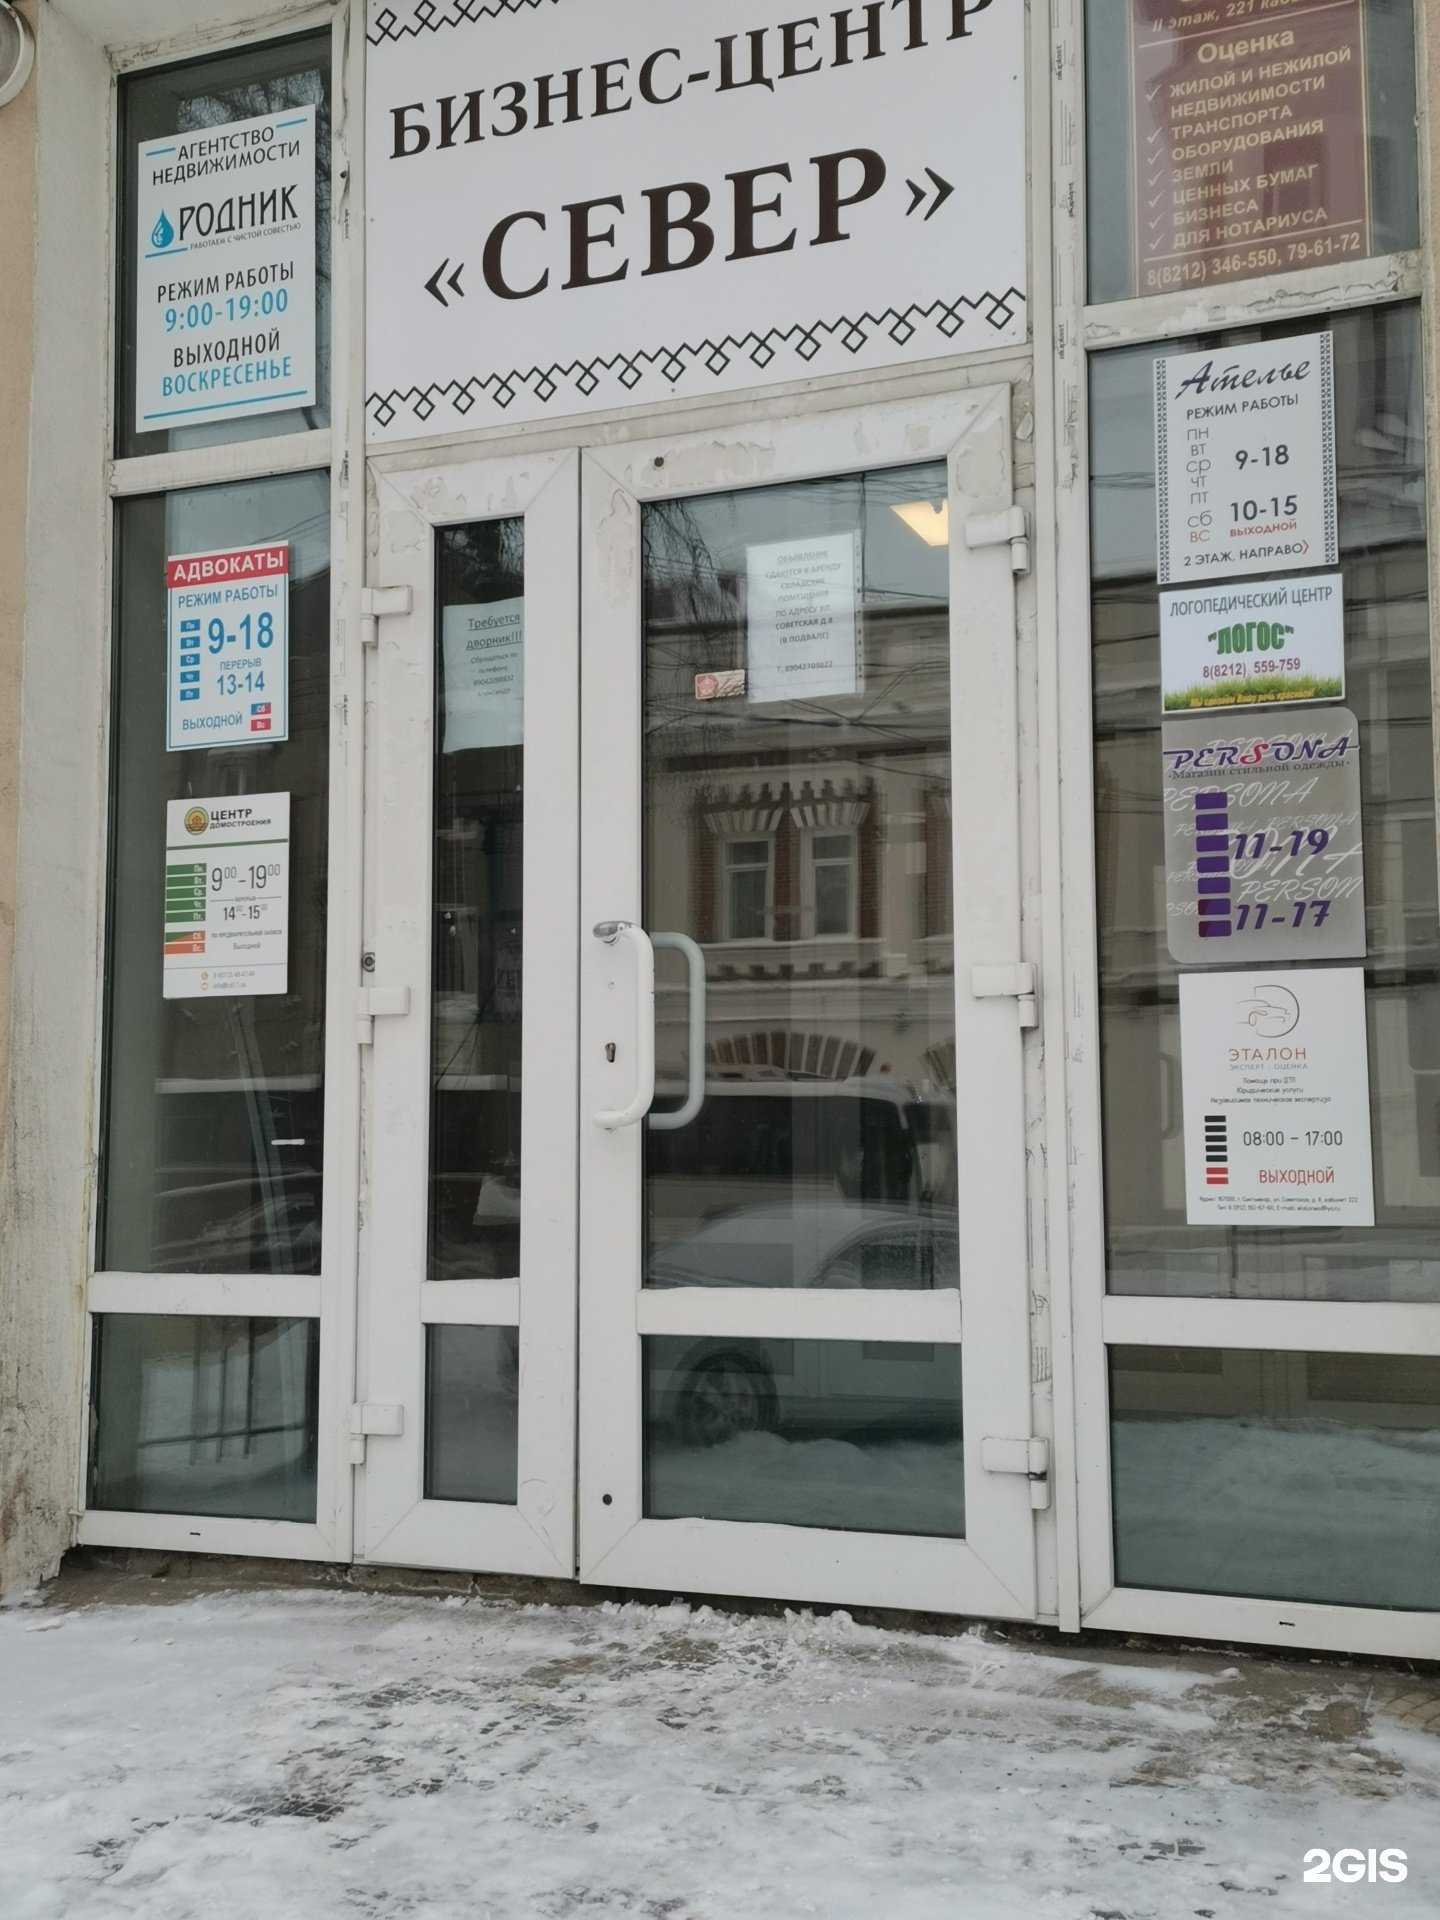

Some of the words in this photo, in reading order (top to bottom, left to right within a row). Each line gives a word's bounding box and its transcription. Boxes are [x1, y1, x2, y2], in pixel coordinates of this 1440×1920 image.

[1197, 30, 1296, 65] Оценка
[389, 0, 993, 160] БИЗНЕС-ЦЕНТР
[1169, 69, 1237, 98] ЖИЛОЙ
[1241, 69, 1254, 84] И
[1258, 47, 1352, 82] НЕЖИЛОЙ
[1170, 75, 1326, 120] НЕДВИЖИМОСТИ
[1172, 104, 1293, 140] ТРАНСПОРТА
[177, 126, 275, 162] АГЕНТСТВО
[1172, 119, 1324, 161] ОБОРУДОВАНИЯ
[152, 140, 301, 186] НЕДВИЖИМОСТИ
[1172, 159, 1234, 184] ЗЕМЛИ
[1173, 180, 1251, 206] ЦЕННЫХ
[1256, 163, 1319, 188] БУМАГ
[178, 184, 300, 241] РОДНИК
[424, 147, 955, 308] «СЕВЕР»
[1173, 200, 1260, 227] БИЗНЕСА
[1173, 229, 1210, 251] ДЛЯ
[1216, 207, 1329, 240] НОТАРИУСА
[1147, 258, 1208, 289] 8(8212)
[1212, 247, 1282, 276] 346-550,
[1288, 231, 1361, 262] 79-61-72
[157, 273, 220, 303] РЕЖИМ
[225, 260, 295, 291] РАБОТЫ
[165, 287, 289, 333] 9:00-19:00
[173, 327, 281, 368] ВЫХОДНОЙ
[162, 355, 293, 397] ВОСКРЕСЕНЬЕ
[1174, 360, 1311, 400] Ателье
[1186, 402, 1237, 420] РЕЖИМ
[1241, 393, 1299, 412] РАБОТЫ
[1186, 427, 1209, 441] ПН
[1190, 444, 1207, 456] ВТ
[1235, 444, 1290, 470] 9-18
[1186, 459, 1211, 474] СР
[1191, 475, 1207, 488] ЧТ
[1190, 491, 1209, 504] ПТ
[1230, 495, 1298, 522] 10-15
[1189, 529, 1211, 543] ВС
[173, 550, 284, 582] АДВОКАТЫ
[1184, 555, 1192, 567] 2
[1239, 542, 1303, 560] НАПРАВО
[178, 590, 221, 608] РЕЖИМ
[225, 584, 278, 603] РАБОТЫ
[1170, 586, 1288, 617] ЛОГОПЕДИЧЕСКИЙ
[1291, 586, 1333, 605] ЦЕНТР
[208, 611, 274, 655] 9-18
[467, 613, 520, 631] Требуется
[1207, 620, 1295, 655] "ЛОГОС"
[219, 657, 262, 672] ПЕРЕРЫВ
[1203, 662, 1247, 680] 8(8212)
[1254, 657, 1301, 674] 559-759
[217, 670, 265, 696] 13-14
[182, 710, 243, 730] ВЫХОДНОЙ
[1163, 737, 1360, 769] PERSONA
[210, 808, 253, 822] ЦЕНТР
[1228, 1047, 1307, 1062] ЭТАЛОН
[1243, 1131, 1285, 1147] 08:00
[1305, 1130, 1343, 1146] 17:00
[1259, 1166, 1335, 1186] ВЫХОДНОЙ
